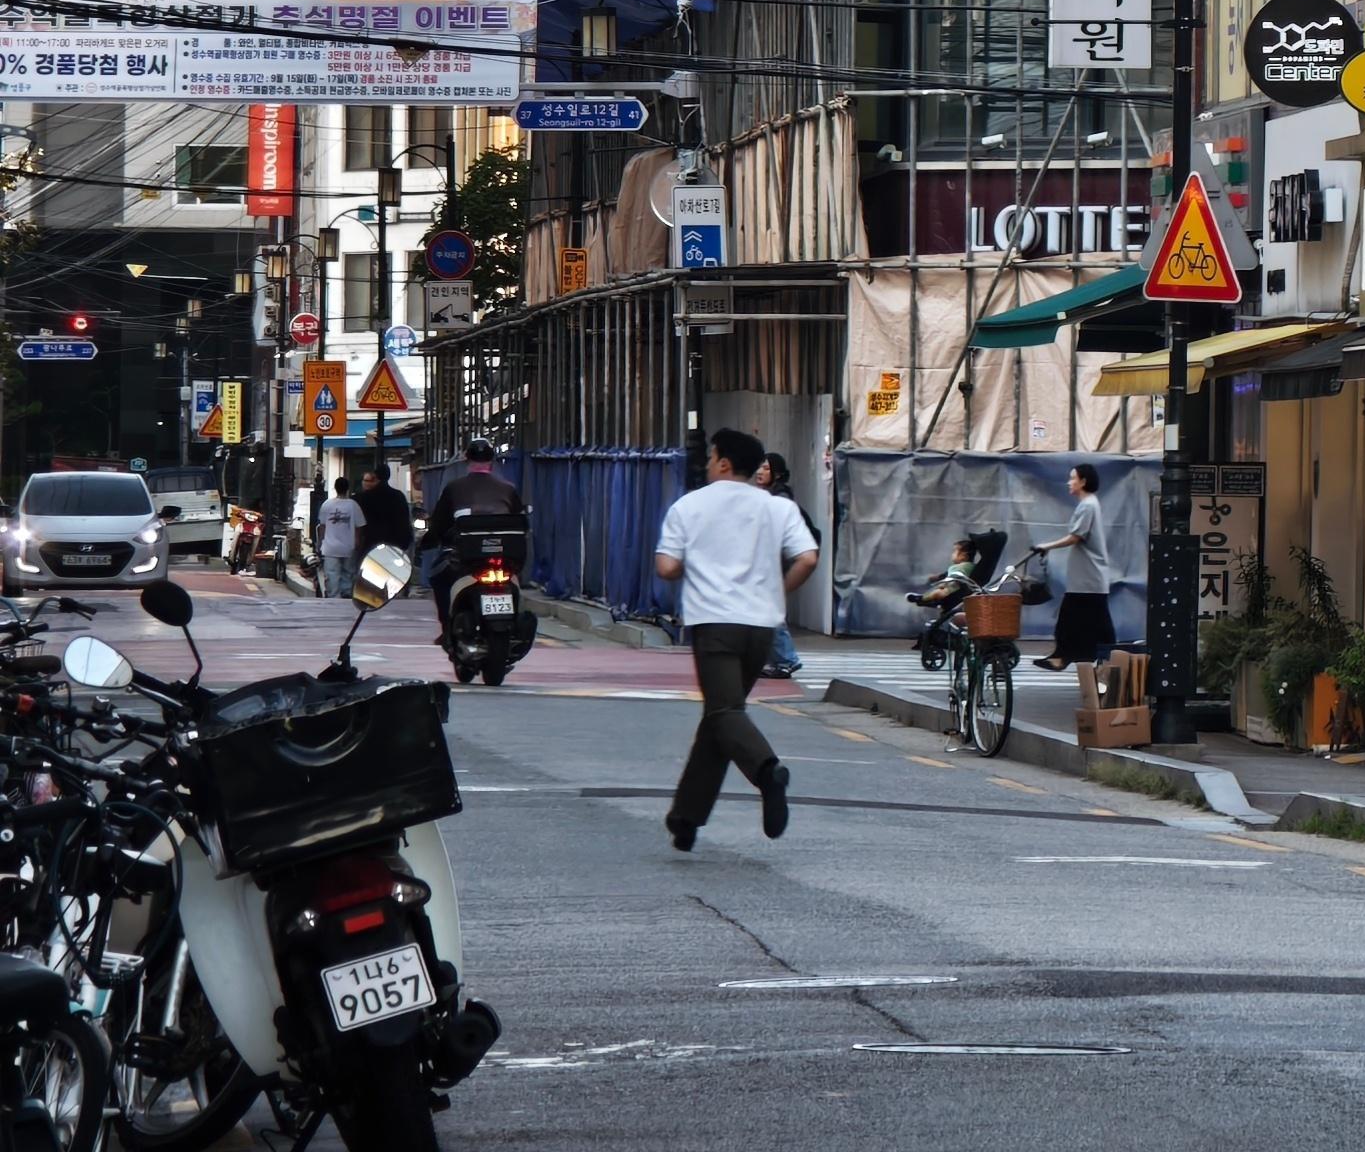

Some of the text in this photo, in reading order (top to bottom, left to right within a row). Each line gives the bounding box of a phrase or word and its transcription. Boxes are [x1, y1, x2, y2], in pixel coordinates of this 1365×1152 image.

[272, 5, 509, 29] 추석명절 이벤트
[354, 51, 371, 61] 이상
[35, 54, 168, 77] 경품당첨 행사
[354, 63, 371, 72] 이상
[454, 63, 471, 72] 지급
[1264, 63, 1344, 81] Center
[541, 103, 619, 117] 성수일로12길
[971, 204, 1149, 253] LOTTE
[320, 417, 331, 428] 30
[340, 975, 423, 1023] 9057
